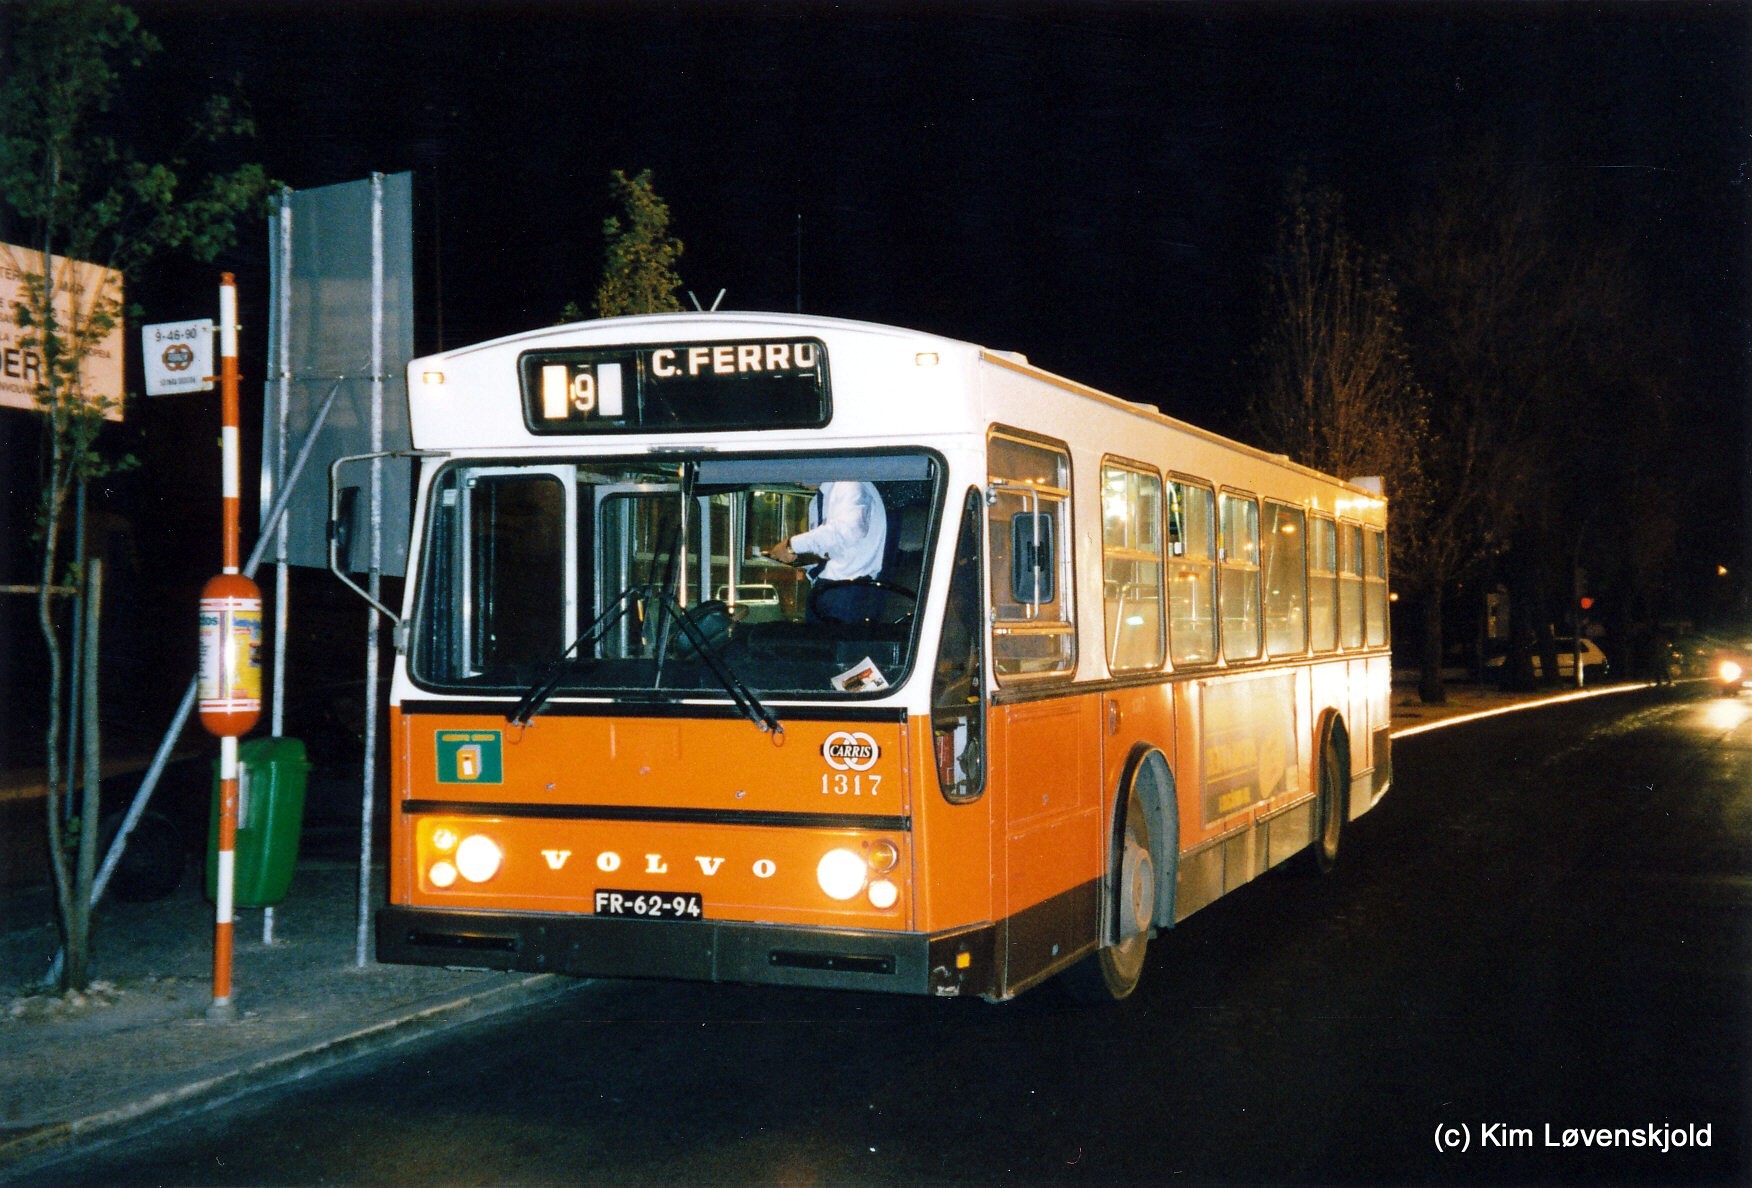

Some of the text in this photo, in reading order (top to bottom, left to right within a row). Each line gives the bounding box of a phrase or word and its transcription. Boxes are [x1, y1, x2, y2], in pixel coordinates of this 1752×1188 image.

[0, 347, 40, 382] ER
[574, 373, 595, 412] 9
[829, 745, 873, 758] CARRIS
[821, 773, 882, 796] 1317
[540, 850, 777, 878] VOLVO
[595, 892, 701, 918] FR-62-94
